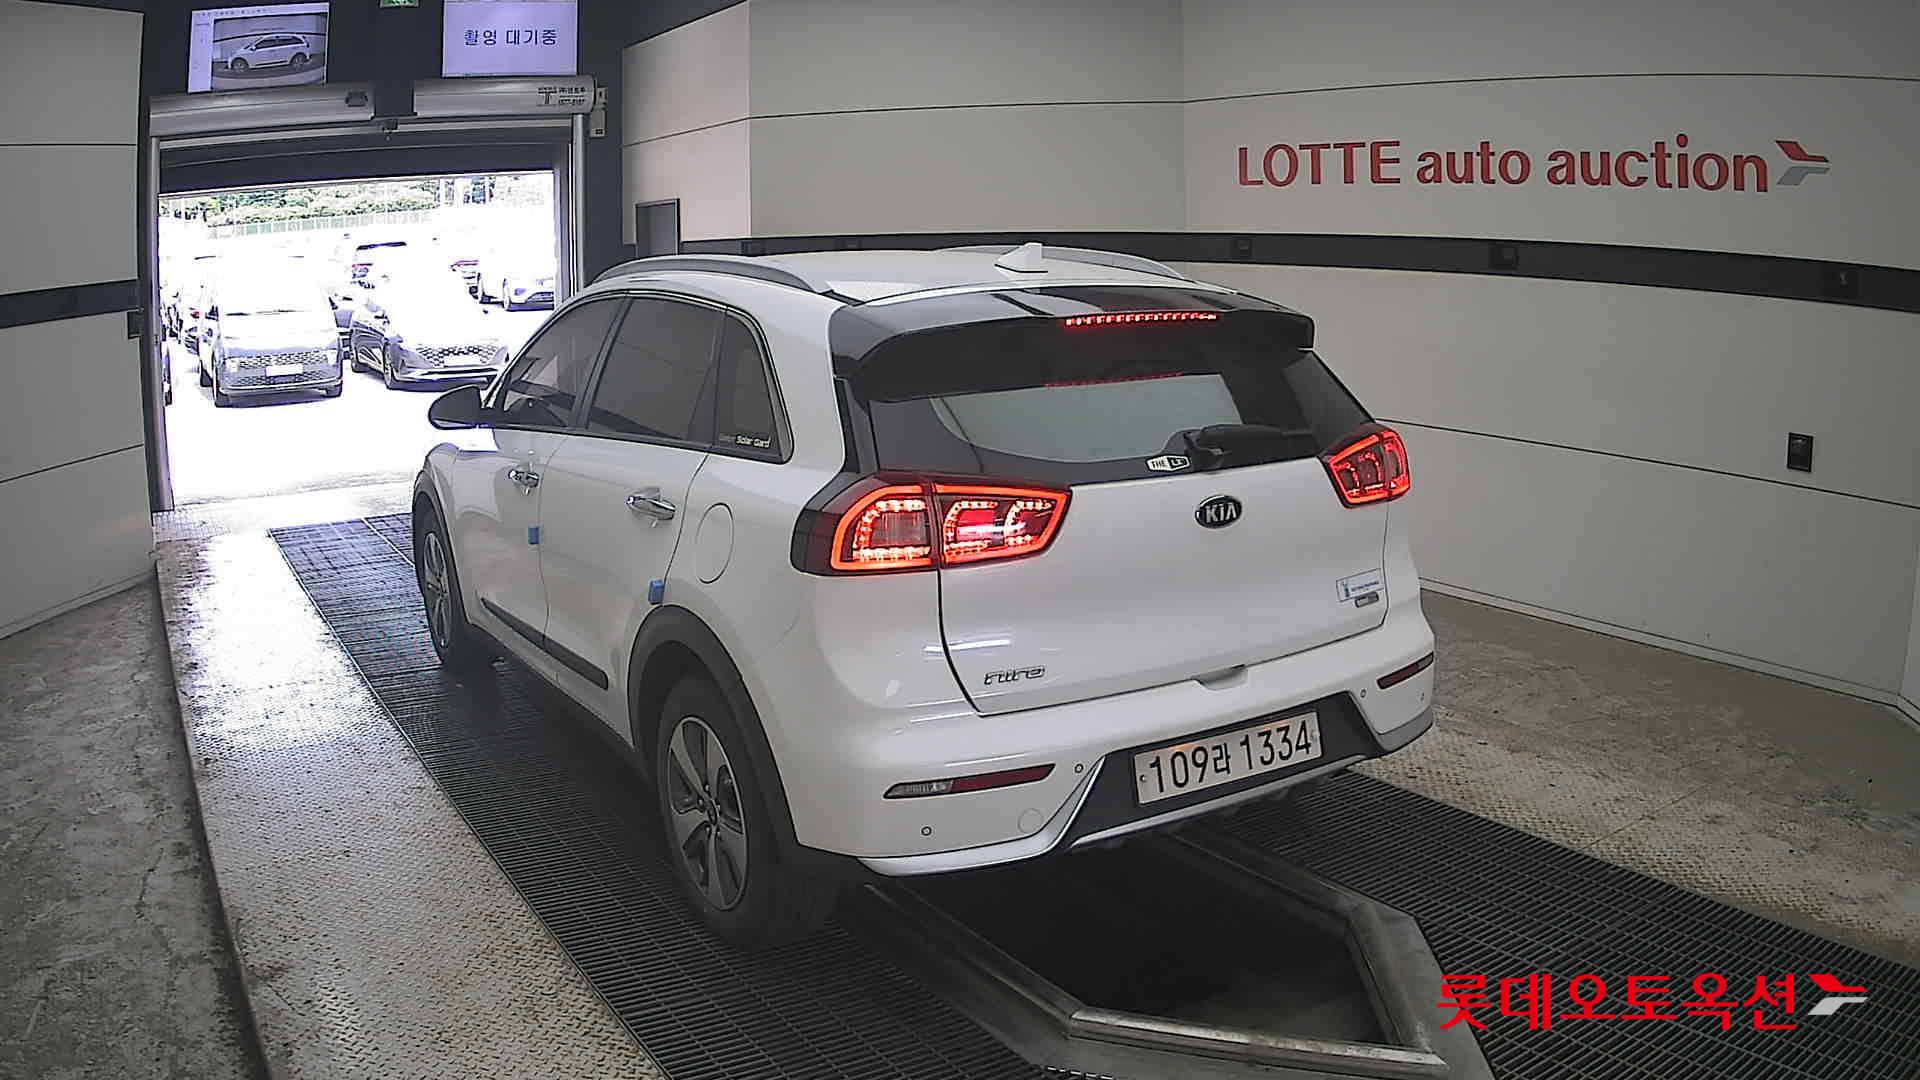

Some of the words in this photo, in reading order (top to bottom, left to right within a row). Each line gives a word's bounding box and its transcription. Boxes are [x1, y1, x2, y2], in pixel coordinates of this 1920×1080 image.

[506, 29, 557, 46] 대기중
[1237, 140, 1401, 188] LOTTE
[1416, 140, 1532, 186] auto
[1545, 132, 1770, 194] auction
[1205, 502, 1237, 523] KIA
[1149, 742, 1231, 793] 109라
[1239, 719, 1311, 770] 1334
